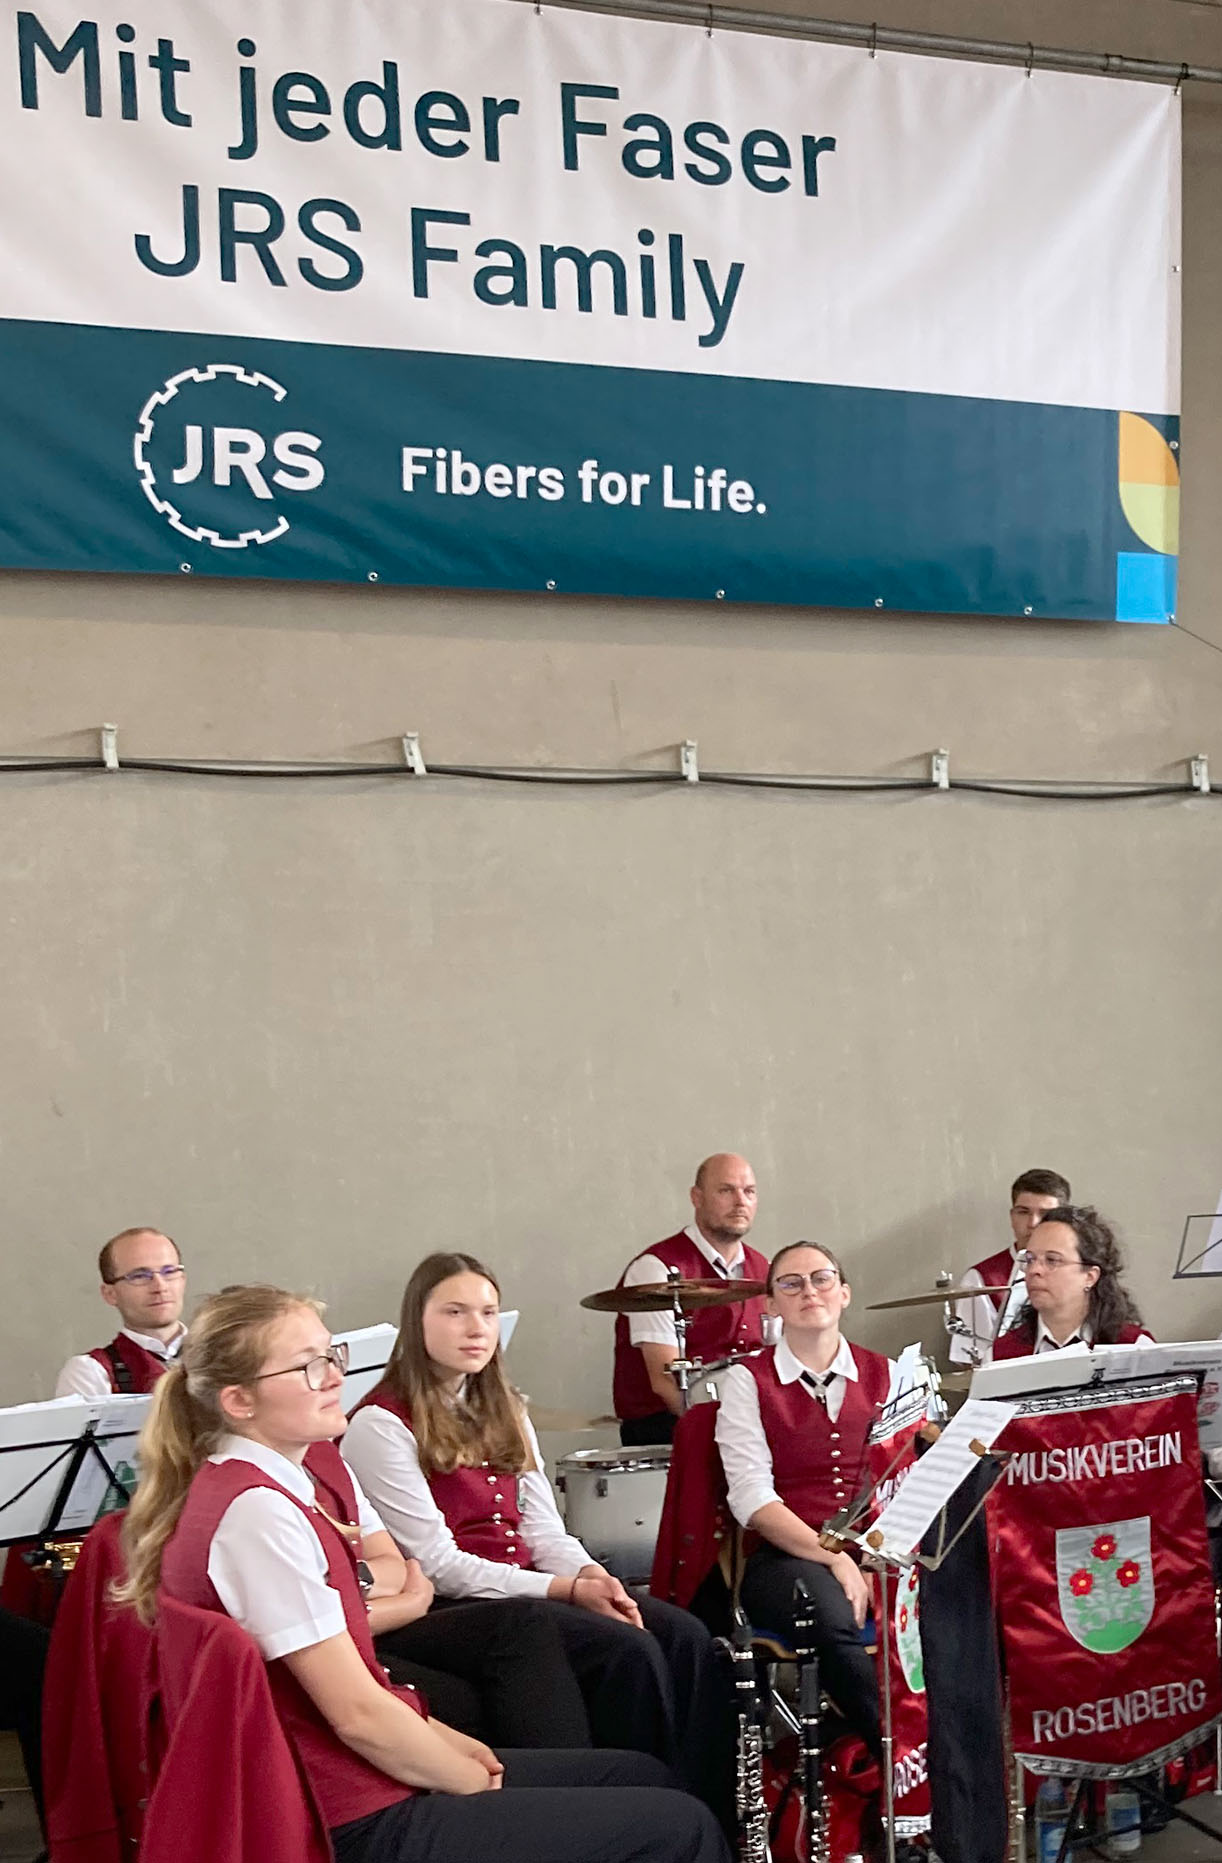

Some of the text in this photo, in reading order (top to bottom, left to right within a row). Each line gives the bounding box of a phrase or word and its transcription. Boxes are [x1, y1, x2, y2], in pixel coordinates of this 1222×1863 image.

[16, 10, 837, 198] Mit jeder Faser
[134, 184, 745, 348] JRS Family
[172, 425, 325, 499] JRS
[402, 446, 767, 514] Fibers for Life.
[1007, 1431, 1183, 1486] MUSIKVEREIN
[1032, 1678, 1207, 1744] ROSENBERG
